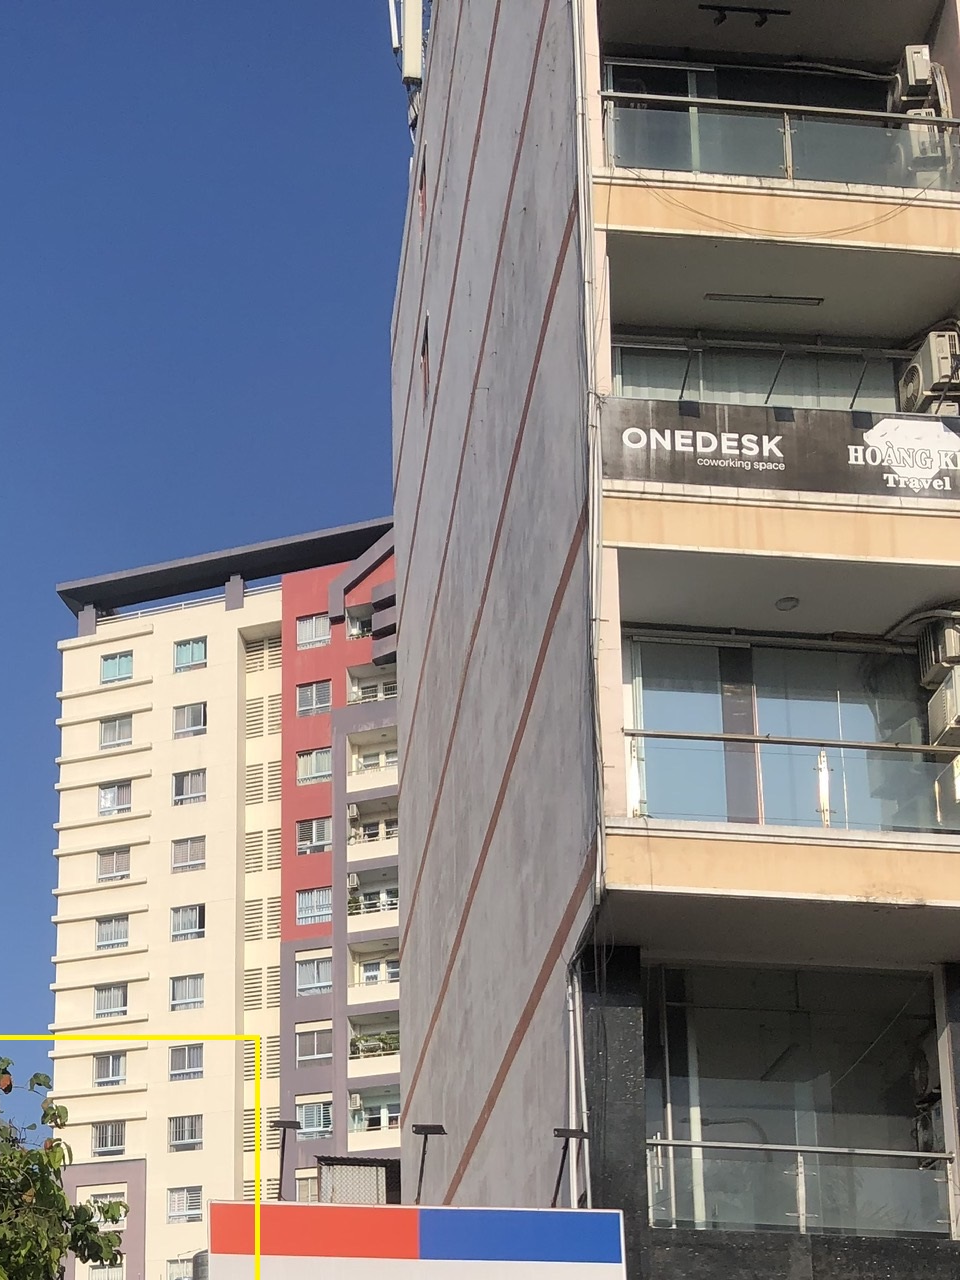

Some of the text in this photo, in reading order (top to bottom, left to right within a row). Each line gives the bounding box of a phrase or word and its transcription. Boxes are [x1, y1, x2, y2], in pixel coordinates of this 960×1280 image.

[622, 427, 784, 457] ONEDESK
[697, 458, 786, 471] coworking space
[847, 441, 933, 469] HOÀNG
[883, 474, 952, 490] Travel
